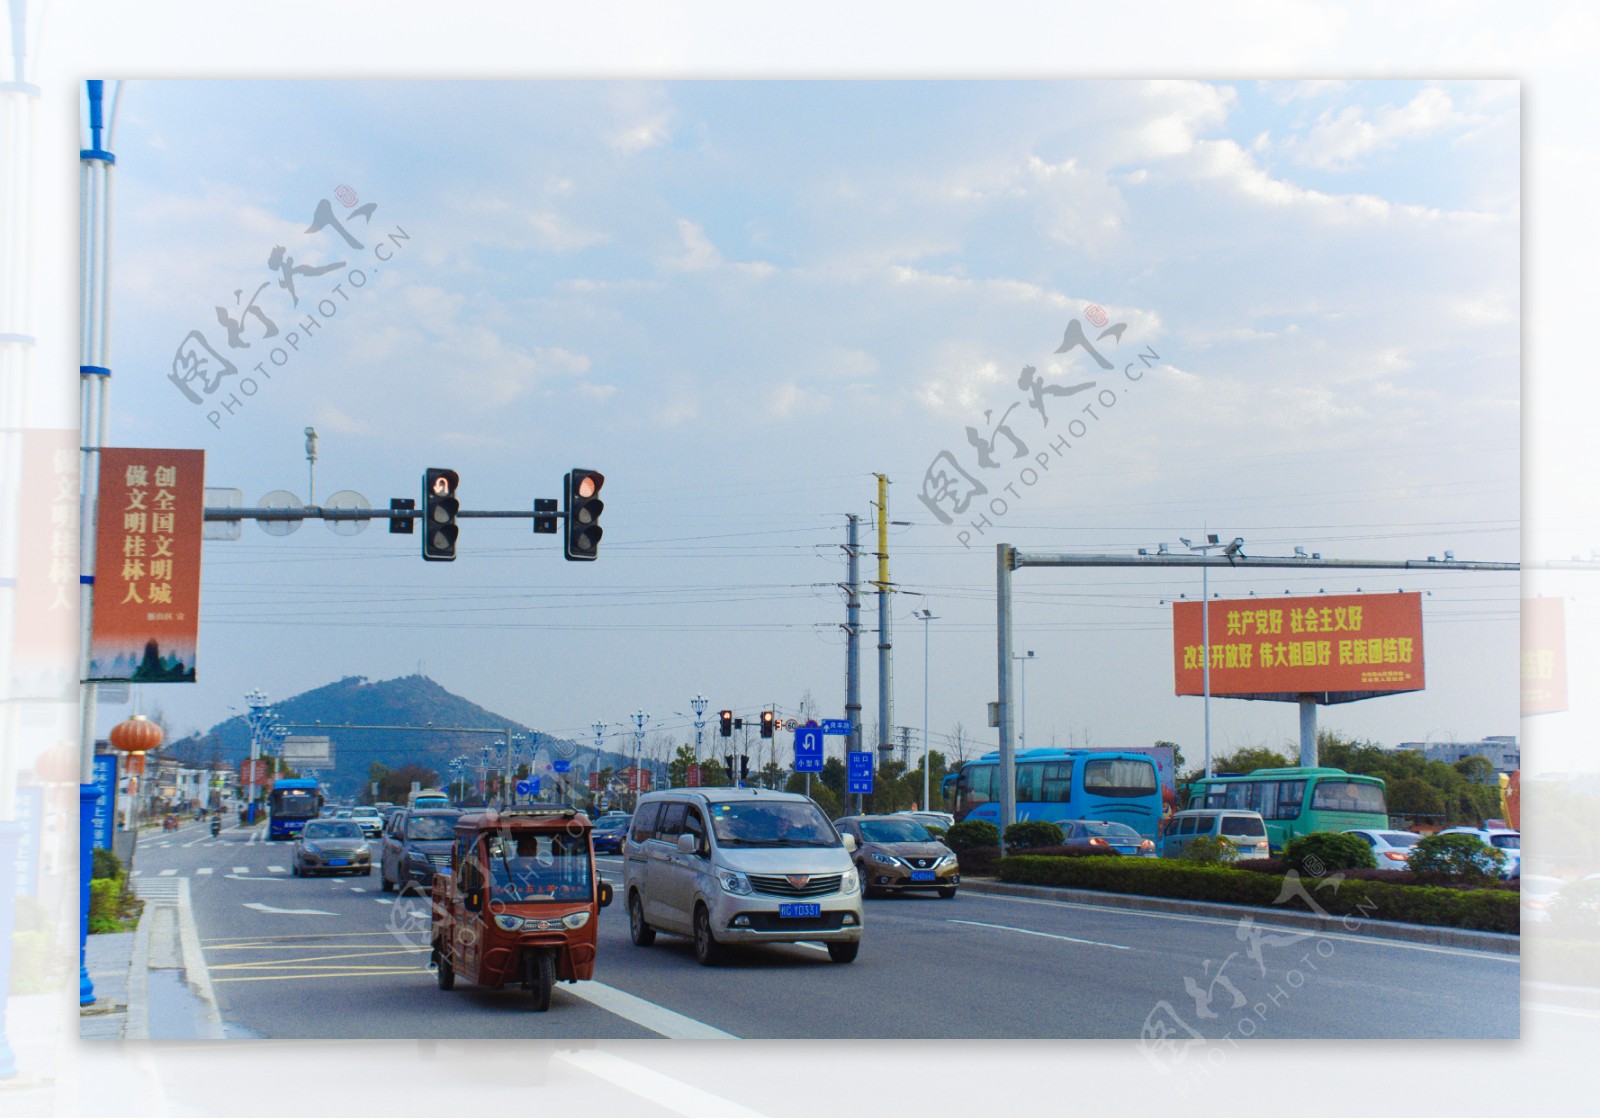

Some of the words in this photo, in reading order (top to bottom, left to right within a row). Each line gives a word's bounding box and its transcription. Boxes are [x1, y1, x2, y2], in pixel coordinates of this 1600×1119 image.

[121, 464, 149, 605] 做文明桂林人
[148, 464, 177, 605] 创全国文明城
[1227, 608, 1283, 636] 共产党好
[1290, 605, 1363, 634] 社会主义好
[1259, 640, 1332, 668] 伟大祖国好
[1339, 637, 1413, 665] 民族团结好
[787, 722, 796, 730] 60
[797, 759, 821, 768] 小型车
